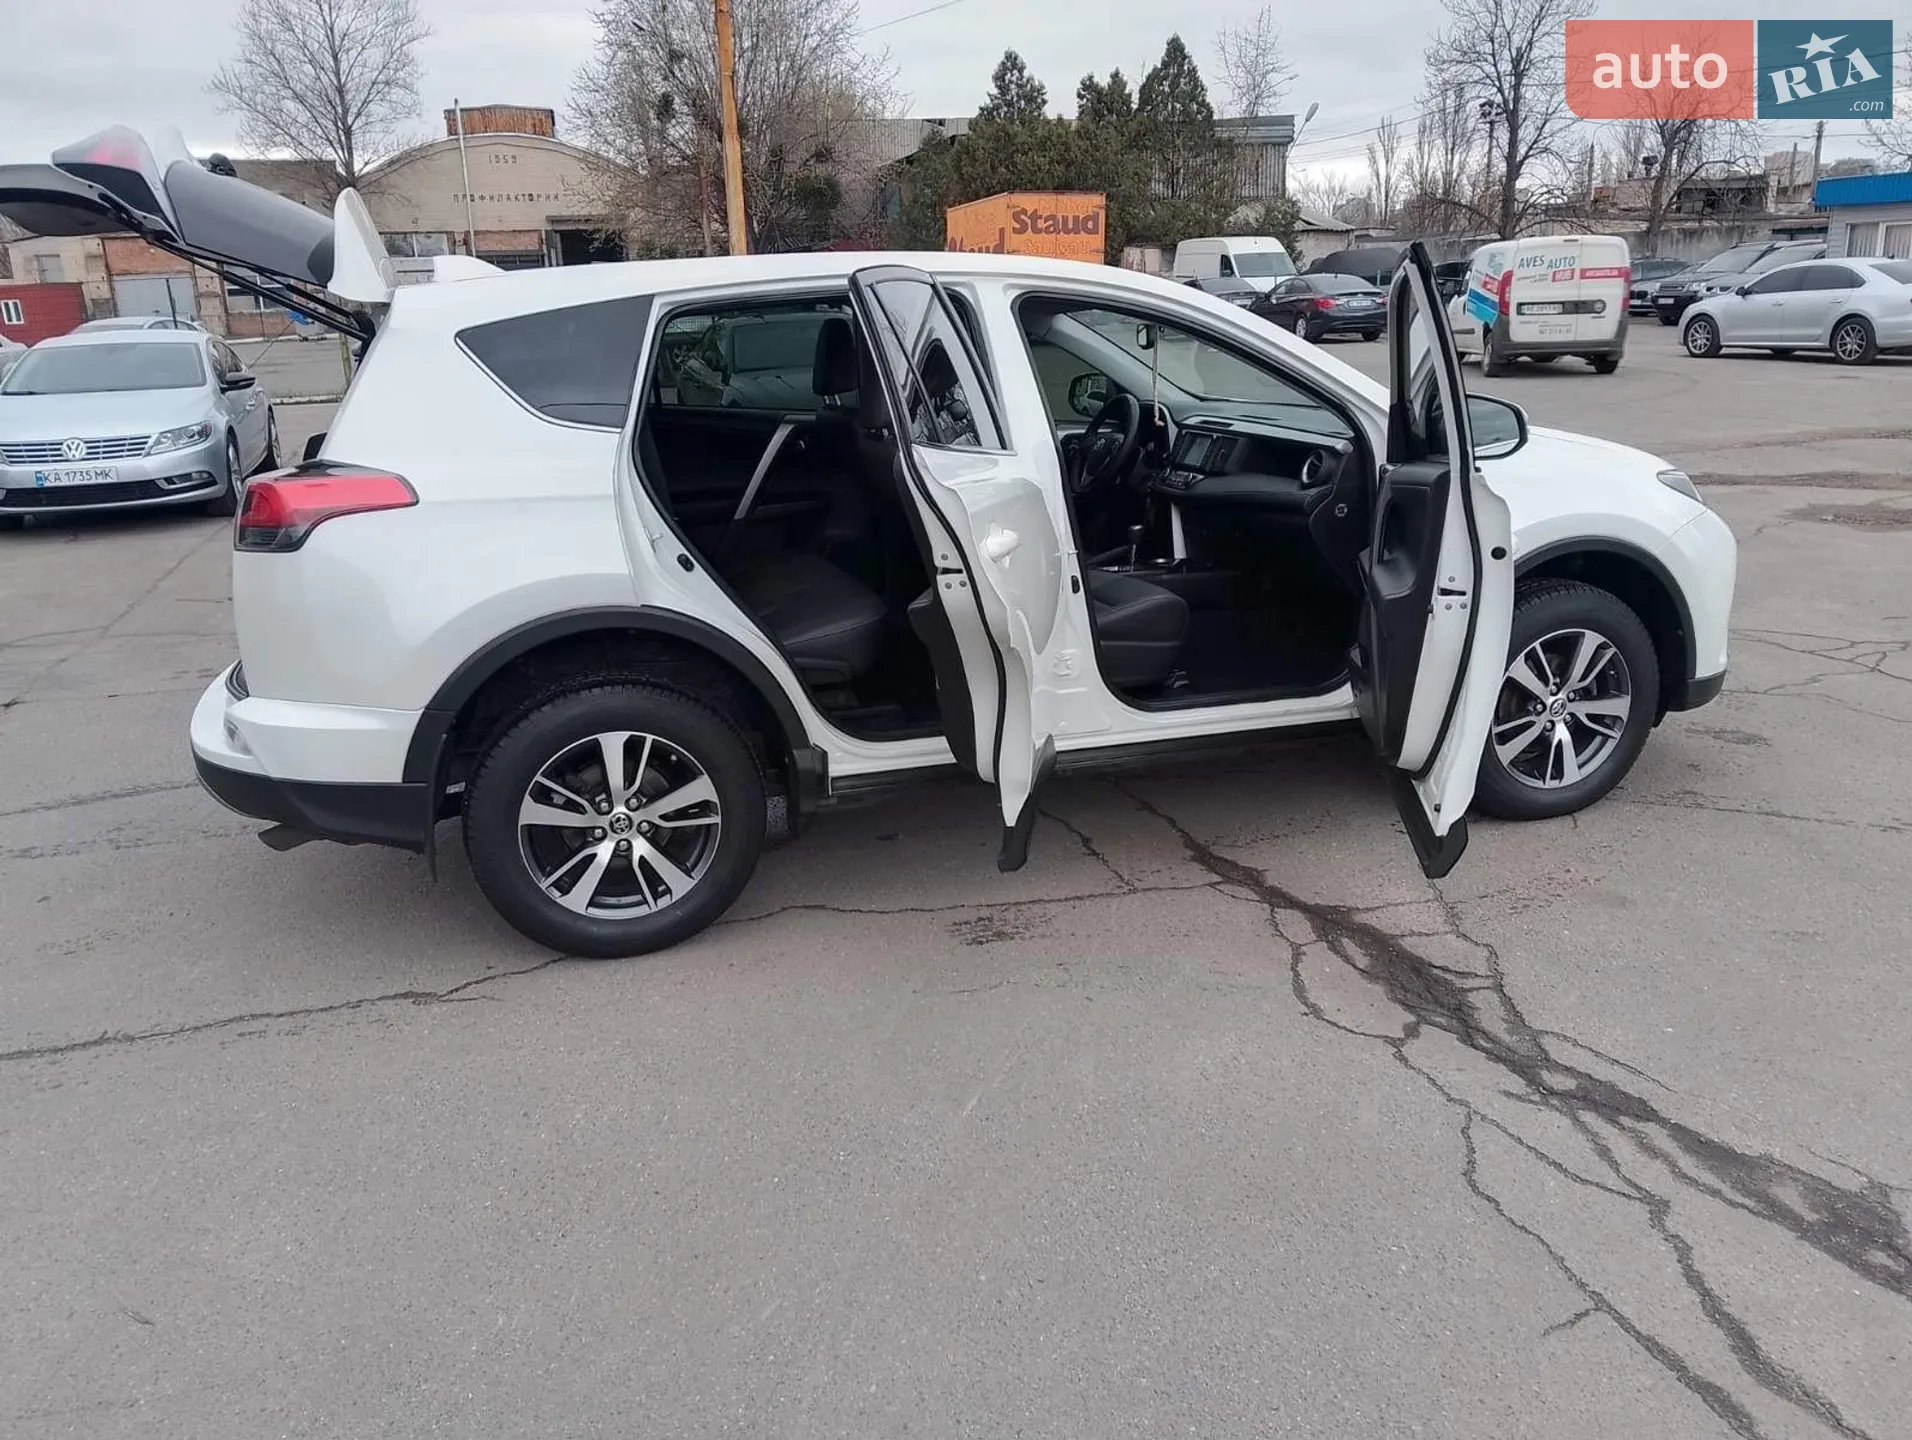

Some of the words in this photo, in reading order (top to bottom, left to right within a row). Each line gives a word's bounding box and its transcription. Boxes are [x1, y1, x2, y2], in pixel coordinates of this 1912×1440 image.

[1012, 208, 1100, 236] Staud
[1518, 255, 1545, 269] AVES
[1547, 256, 1576, 270] AUTO
[45, 471, 63, 484] KA
[64, 469, 93, 482] 1735
[94, 468, 113, 481] MK
